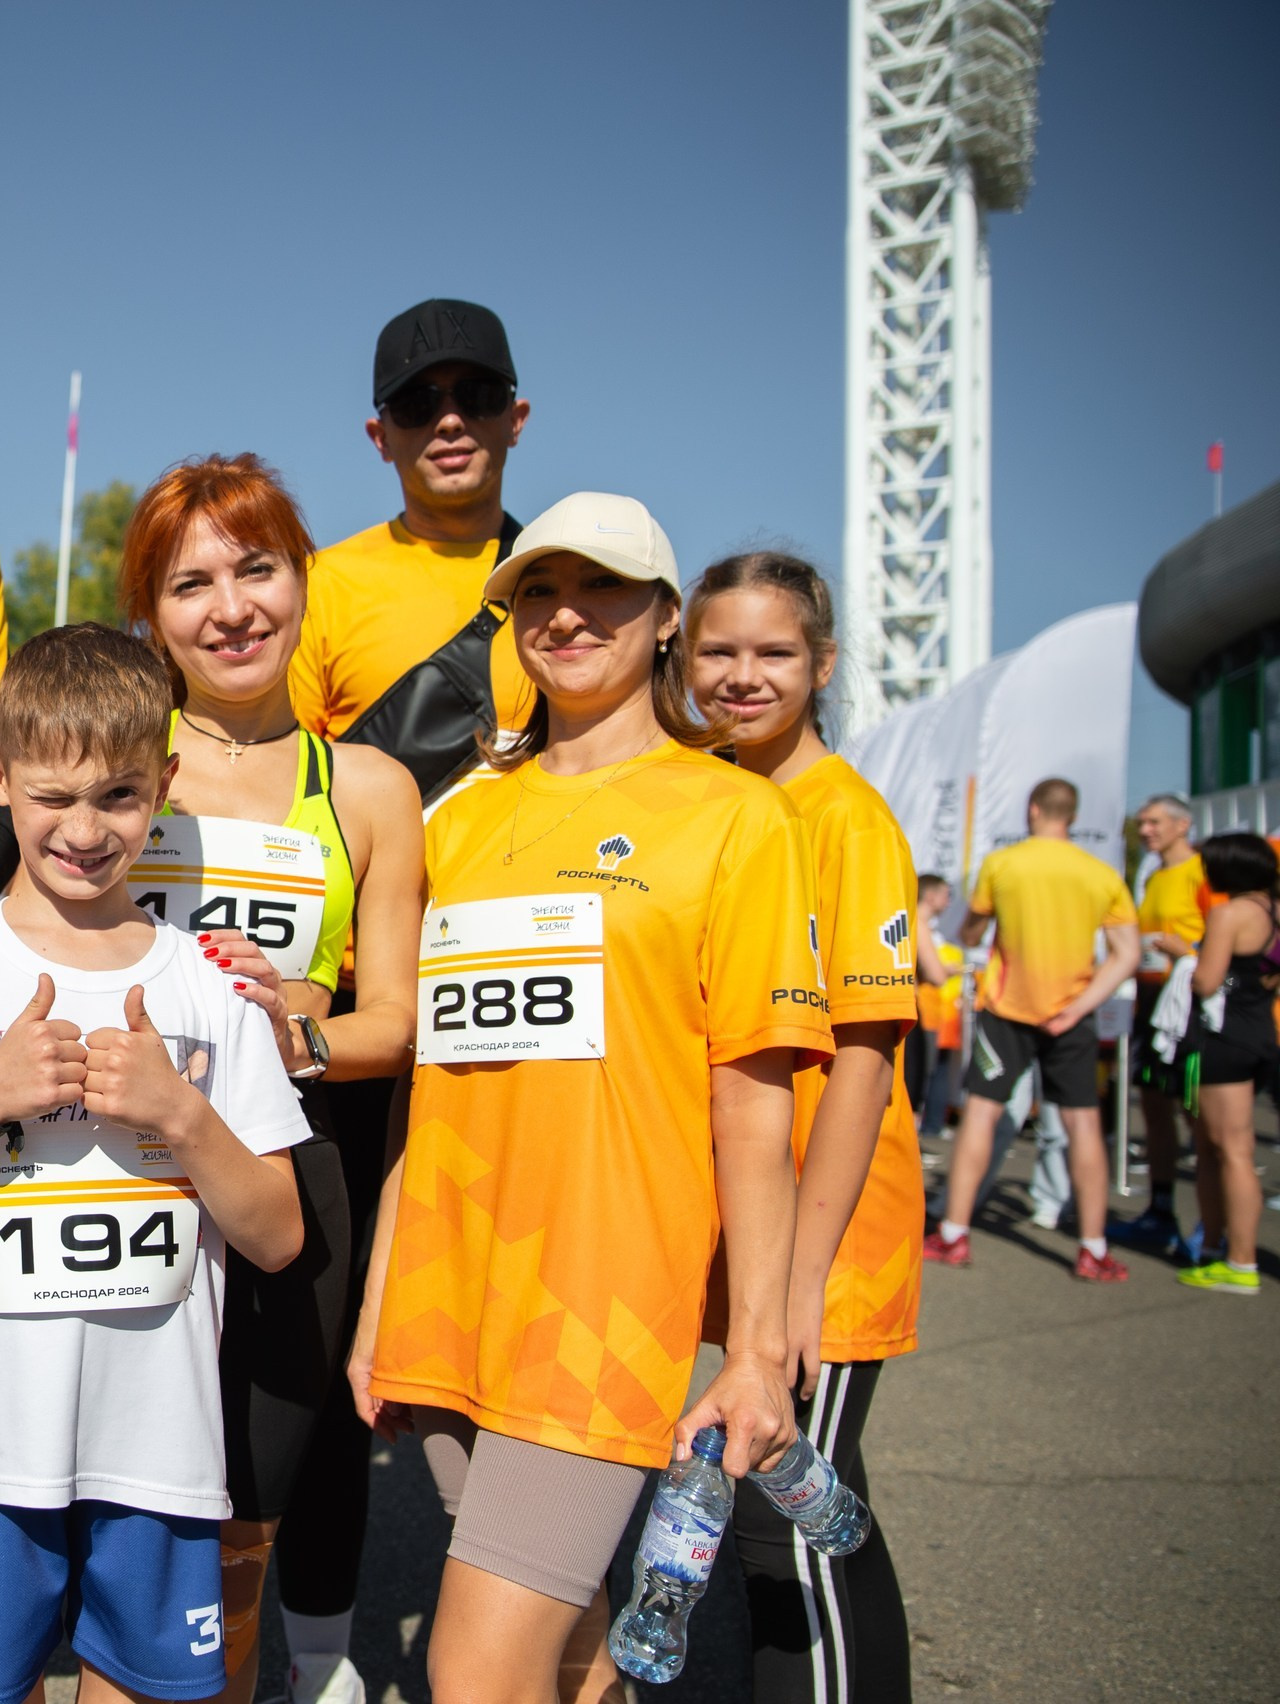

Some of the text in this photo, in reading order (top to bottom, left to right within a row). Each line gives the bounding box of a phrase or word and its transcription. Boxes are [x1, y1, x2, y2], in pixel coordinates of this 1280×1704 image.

[556, 870, 650, 892] РОСНЕФТЬ
[134, 891, 297, 949] 145
[531, 905, 575, 916] ЭНЕРГИЯ
[430, 939, 461, 949] РОСНЕФТЬ
[432, 975, 575, 1032] 288
[771, 988, 830, 1014] РОСНЕ
[453, 1040, 540, 1052] КРАСНОДАР 2024
[33, 1285, 150, 1301] КРАСНОДАР 2024
[185, 1603, 220, 1656] 3
